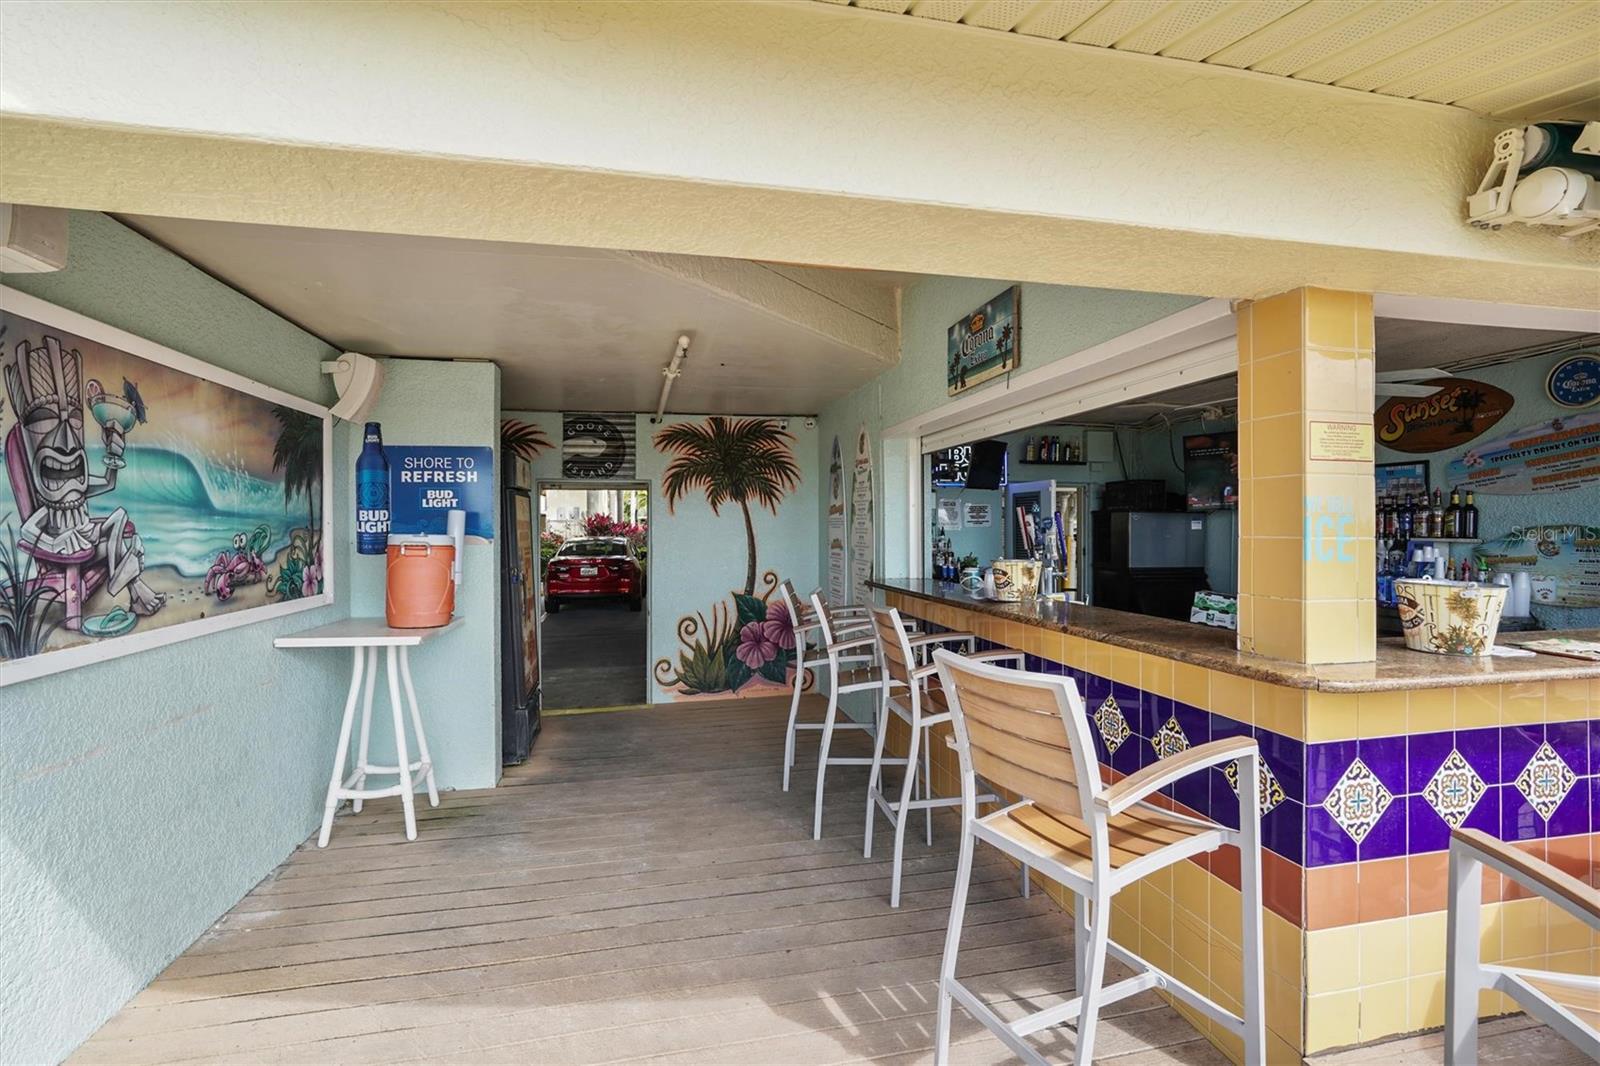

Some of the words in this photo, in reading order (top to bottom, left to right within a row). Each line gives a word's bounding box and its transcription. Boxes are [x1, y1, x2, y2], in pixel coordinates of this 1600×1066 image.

[961, 327, 994, 357] Corona
[1380, 386, 1462, 441] Sunset
[567, 423, 612, 437] GOOSE
[1490, 450, 1531, 463] SPECIALTY
[1534, 443, 1565, 456] DRINKS
[1567, 439, 1580, 448] ON
[404, 457, 452, 469] SHORE
[456, 457, 474, 469] TO
[566, 462, 613, 477] ISLAND
[401, 471, 478, 483] REFRESH
[427, 490, 453, 499] BUD
[422, 499, 458, 507] LIGHT
[359, 510, 389, 521] BUD
[356, 521, 391, 533] LIGHT
[1304, 514, 1354, 564] ICE
